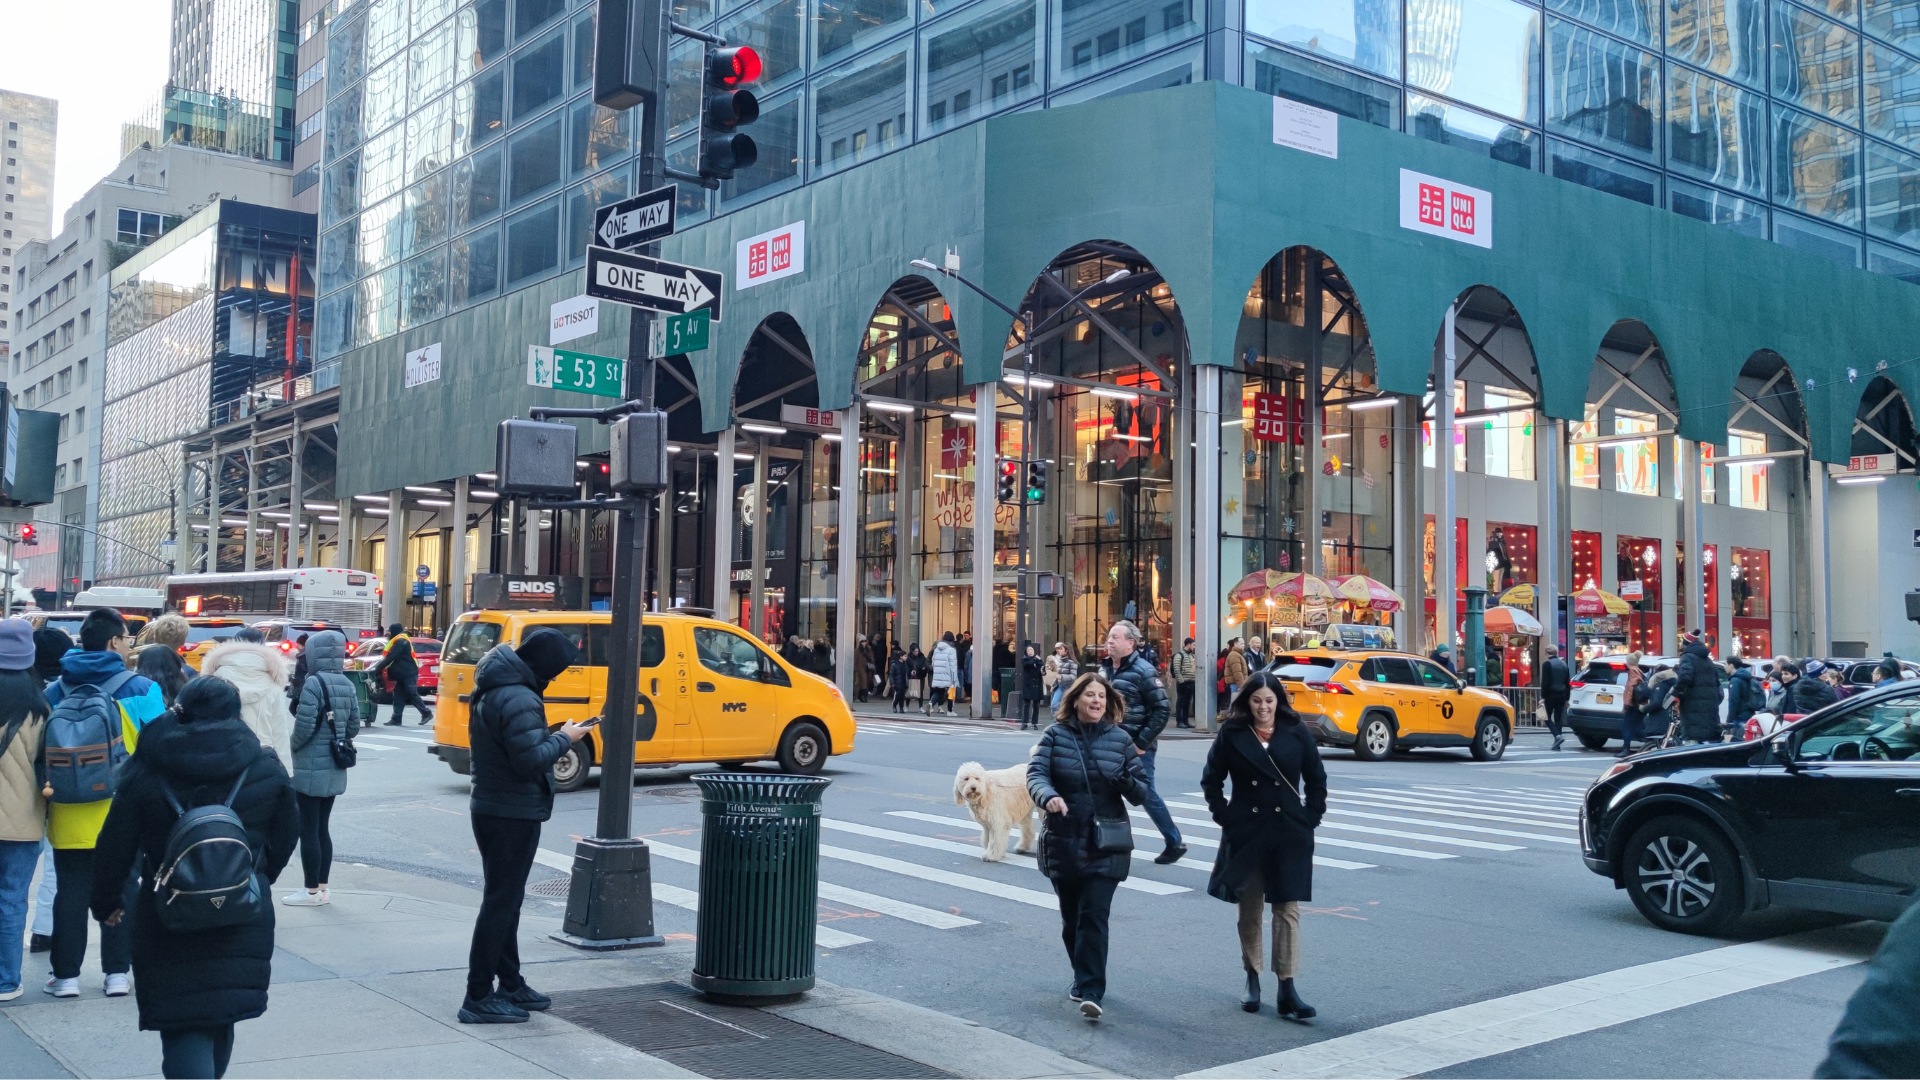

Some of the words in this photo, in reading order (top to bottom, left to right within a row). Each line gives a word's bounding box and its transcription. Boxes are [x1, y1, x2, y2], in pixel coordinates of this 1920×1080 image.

[1452, 196, 1471, 214] UNI
[606, 215, 628, 238] ONE
[639, 205, 664, 228] WAY
[1452, 212, 1473, 230] QLO
[773, 237, 788, 253] UNI
[773, 252, 789, 269] QLO
[607, 266, 645, 291] ONE
[664, 278, 702, 302] WAY
[565, 306, 595, 326] TISSOT
[673, 320, 681, 349] 5
[687, 318, 699, 335] Av
[407, 361, 440, 386] HOLLISTER
[553, 355, 564, 384] E
[574, 358, 596, 389] 53
[606, 363, 618, 381] St
[936, 483, 985, 508] WAR
[571, 524, 607, 543] HOSTER
[508, 581, 555, 593] ENDS
[722, 702, 747, 713] NYC
[726, 803, 746, 812] Fifth
[748, 803, 782, 813] Avenue
